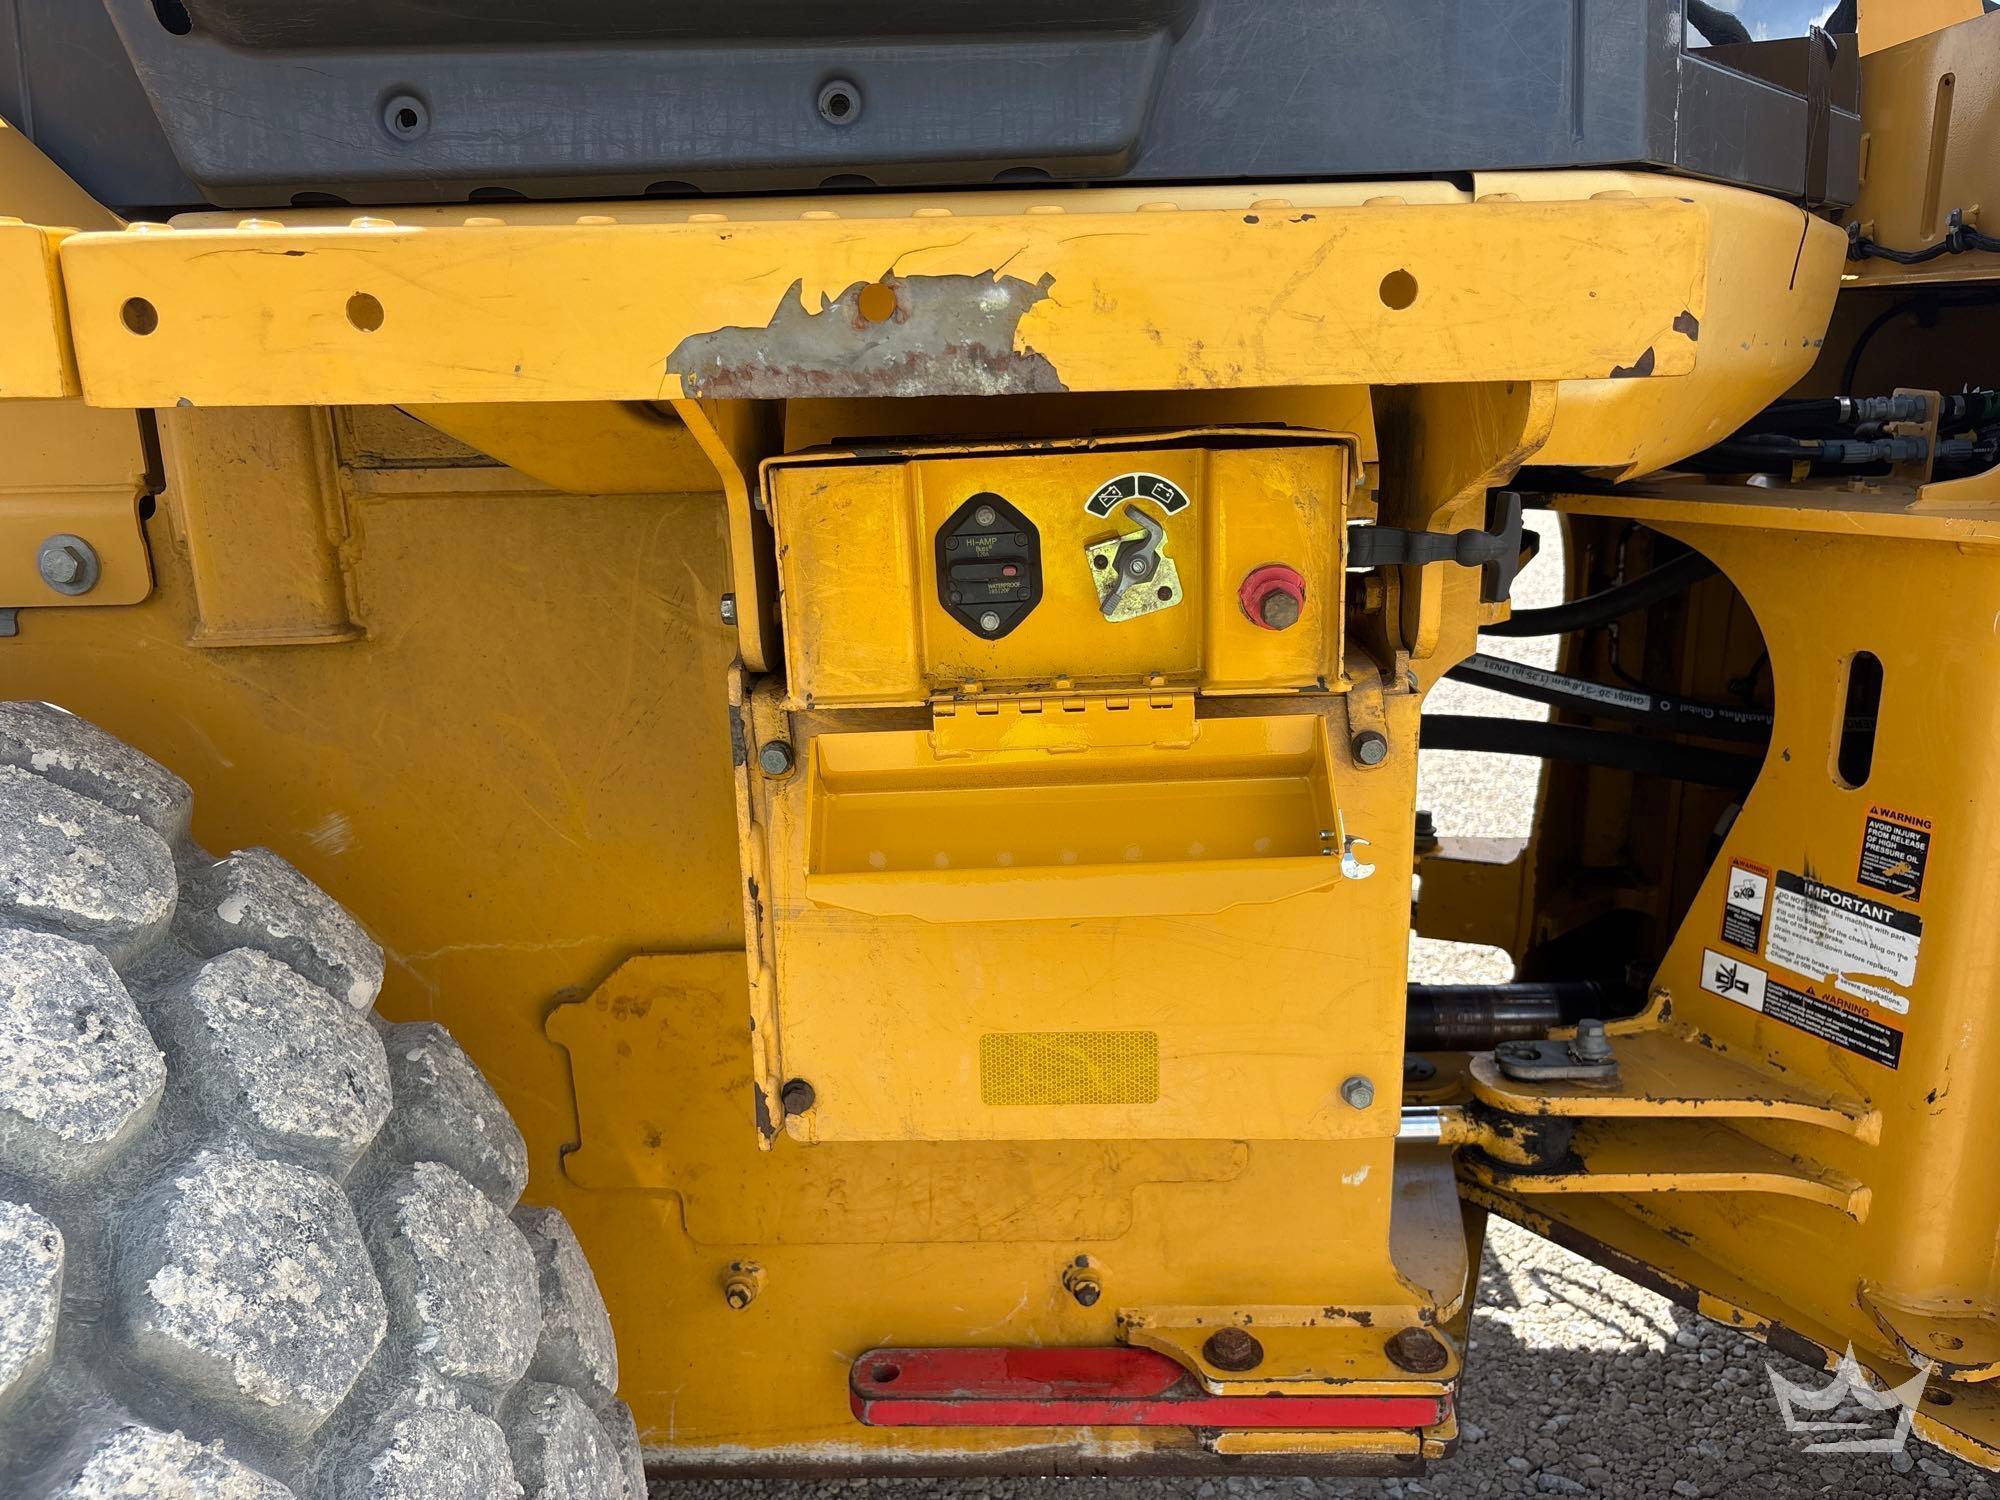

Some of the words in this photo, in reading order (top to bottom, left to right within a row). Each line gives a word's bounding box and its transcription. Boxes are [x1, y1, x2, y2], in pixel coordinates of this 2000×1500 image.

[966, 538, 997, 547] HI-AMP
[1880, 808, 1932, 829] WARNING
[1868, 827, 1889, 840] FROM
[1891, 834, 1925, 850] RELEASE
[1870, 820, 1892, 833] AVOID
[1894, 827, 1920, 841] INJURY
[1866, 842, 1905, 860] PRESSURE
[1907, 854, 1919, 864] OIL
[1867, 835, 1877, 843] OF
[1879, 838, 1897, 849] HIGH
[1740, 860, 1768, 875] WARNING
[1779, 899, 1795, 909] brake
[1803, 882, 1893, 923] IMPORTANT
[1776, 916, 1788, 924] side
[1798, 923, 1807, 931] the
[1809, 928, 1824, 938] park
[1779, 892, 1789, 900] DO
[1790, 896, 1804, 905] NOT
[1831, 910, 1843, 920] this
[1845, 915, 1873, 930] machine
[1874, 926, 1889, 936] with
[1891, 932, 1906, 942] park
[1775, 924, 1791, 935] Drain
[1792, 932, 1814, 944] excess
[1825, 944, 1842, 955] down
[1844, 951, 1865, 963] before
[1867, 959, 1898, 976] replacing
[1805, 919, 1827, 931] bottom
[1837, 930, 1847, 938] the
[1849, 935, 1868, 946] check
[1870, 942, 1885, 954] plug
[1898, 952, 1908, 961] the
[1771, 950, 1792, 964] Change
[1801, 962, 1811, 970] 500
[1772, 943, 1795, 957] Change
[1796, 953, 1810, 963] park
[1812, 959, 1829, 970] brake
[1841, 979, 1861, 990] severe
[1862, 986, 1902, 1007] applications.
[1822, 992, 1870, 1017] WARNING
